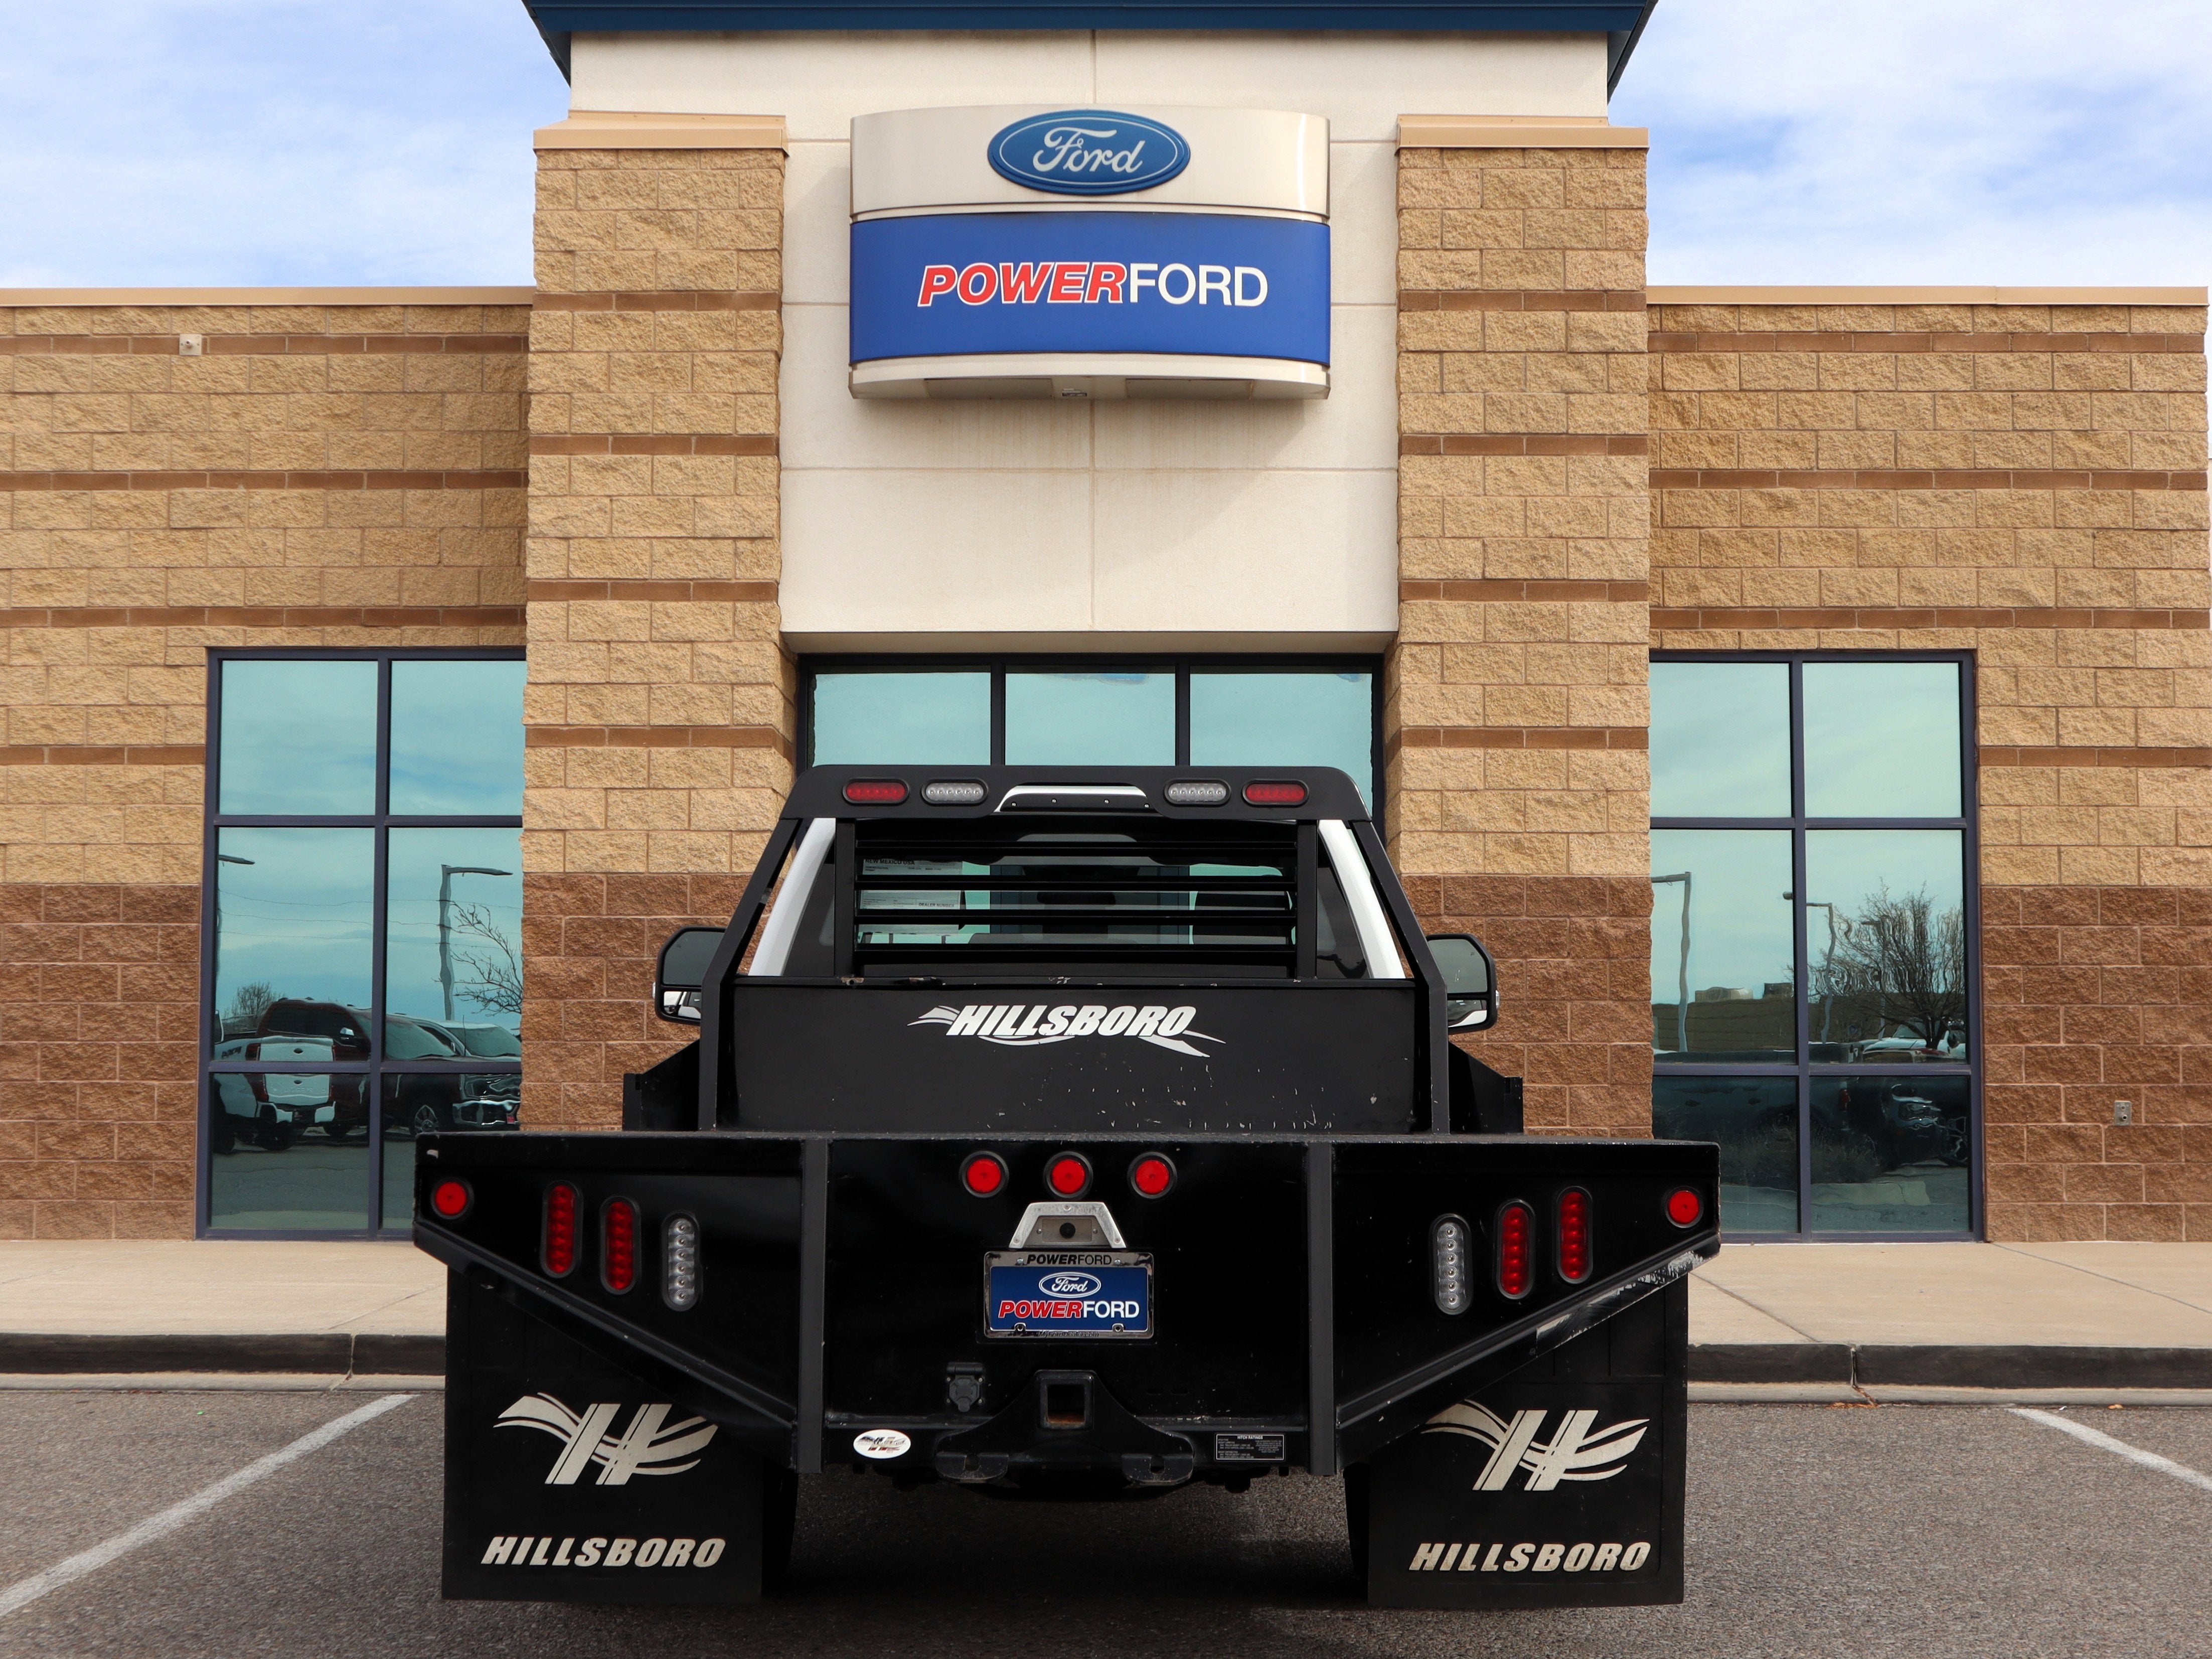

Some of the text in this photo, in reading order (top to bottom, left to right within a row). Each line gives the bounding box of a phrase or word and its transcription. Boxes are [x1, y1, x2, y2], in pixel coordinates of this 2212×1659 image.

[1032, 126, 1146, 174] Ford
[917, 261, 1268, 307] POWERFORD
[945, 1005, 1196, 1036] HILLSBORO
[1026, 1254, 1112, 1265] POWERFORD
[1051, 1276, 1088, 1293] Ford
[998, 1300, 1140, 1319] POWERFORD
[481, 1536, 726, 1568] HILLSBORO
[1409, 1542, 1651, 1572] HILLSBORO
